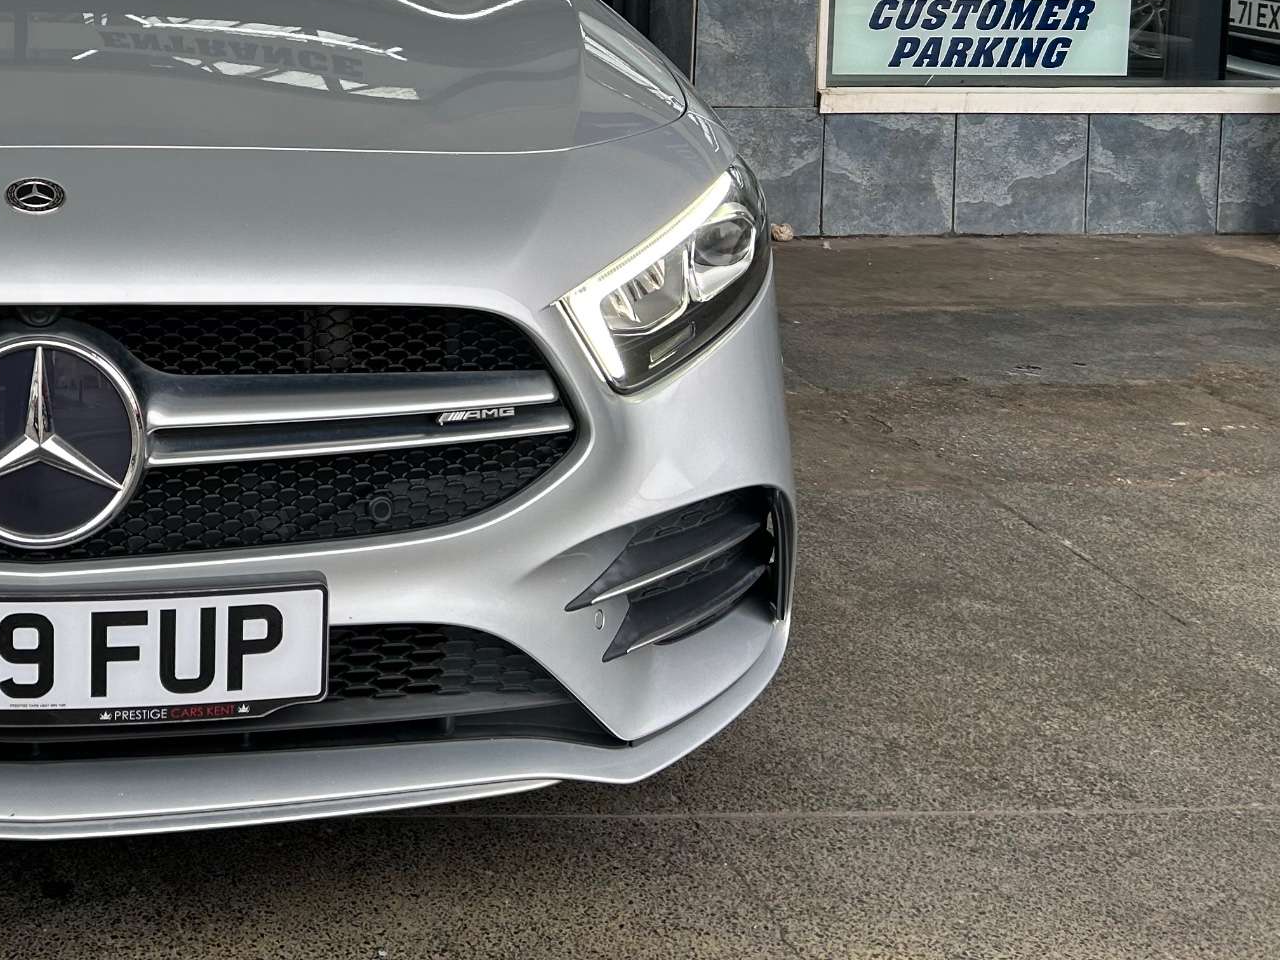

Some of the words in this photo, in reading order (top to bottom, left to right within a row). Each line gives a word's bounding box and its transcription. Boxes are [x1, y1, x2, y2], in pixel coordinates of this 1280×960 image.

[887, 36, 1073, 69] PARKING
[89, 603, 284, 698] FUP
[114, 708, 168, 721] PRESTIGE
[171, 707, 204, 719] CARS
[206, 705, 235, 717] KENT
